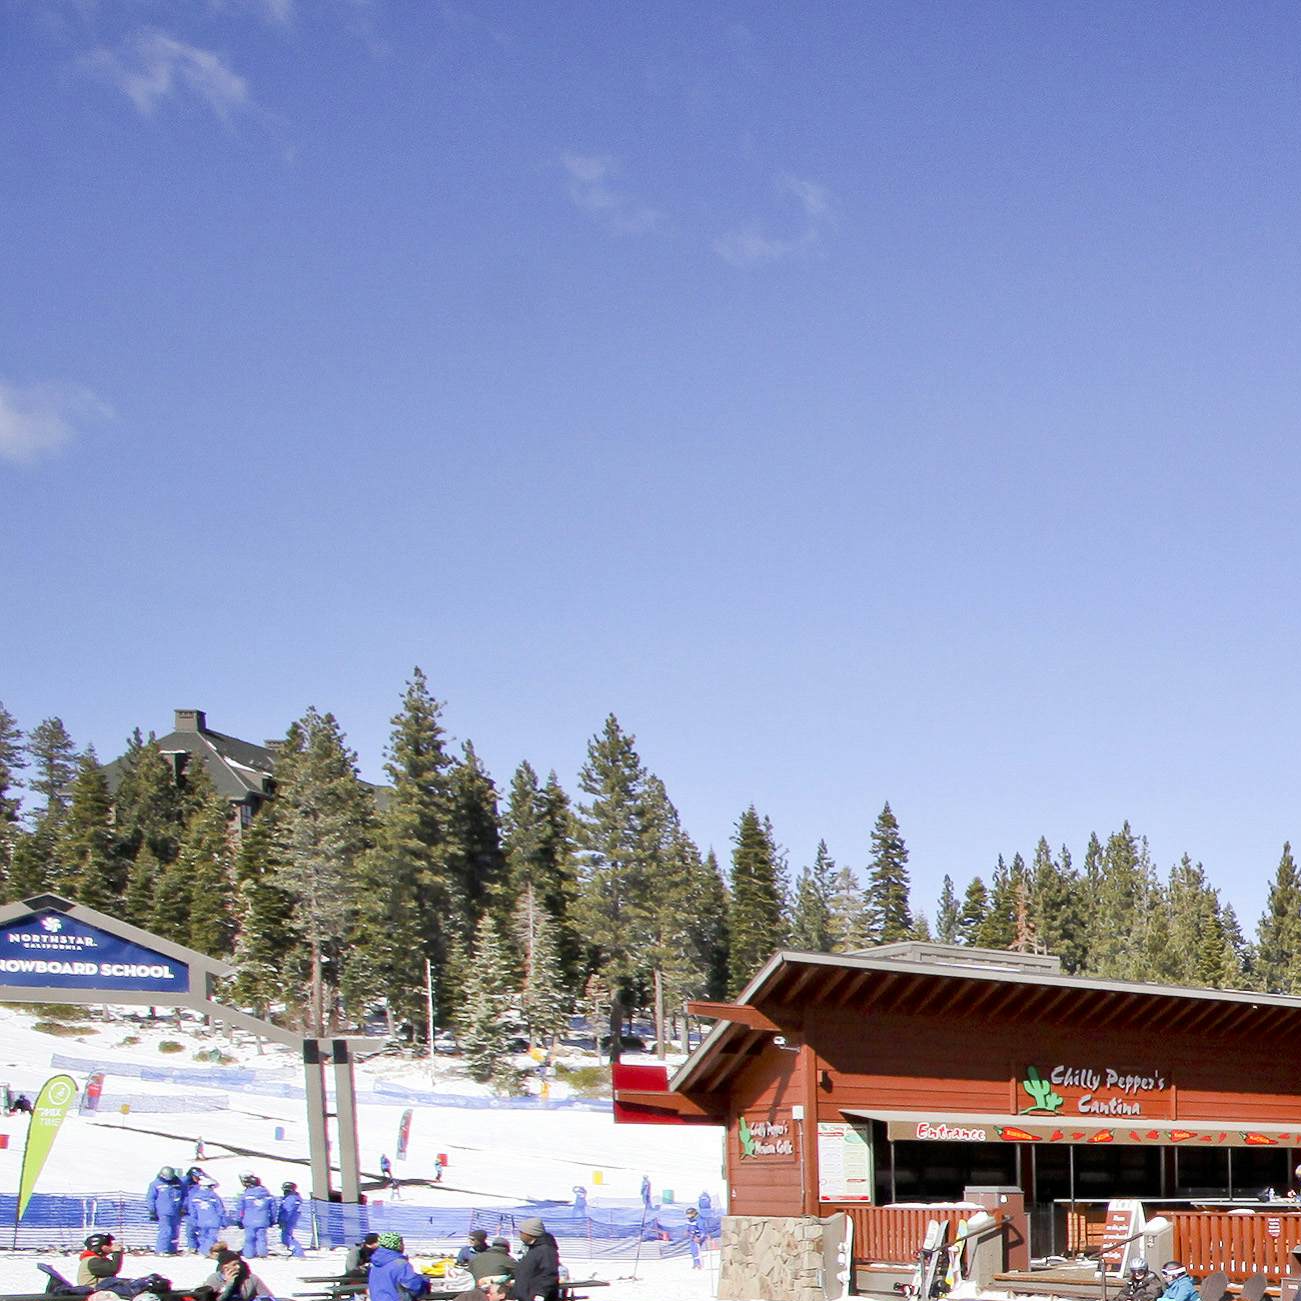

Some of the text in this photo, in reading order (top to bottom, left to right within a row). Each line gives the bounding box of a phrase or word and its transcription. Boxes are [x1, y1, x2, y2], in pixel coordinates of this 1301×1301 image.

[8, 933, 96, 947] NORTHSTAR
[23, 943, 83, 951] CALIFORNIA
[0, 959, 175, 979] NOWBOARD SCHOOL
[1051, 1065, 1165, 1095] Chilly Pepper's
[1078, 1094, 1140, 1115] Cantina
[916, 1123, 986, 1141] Entrance
